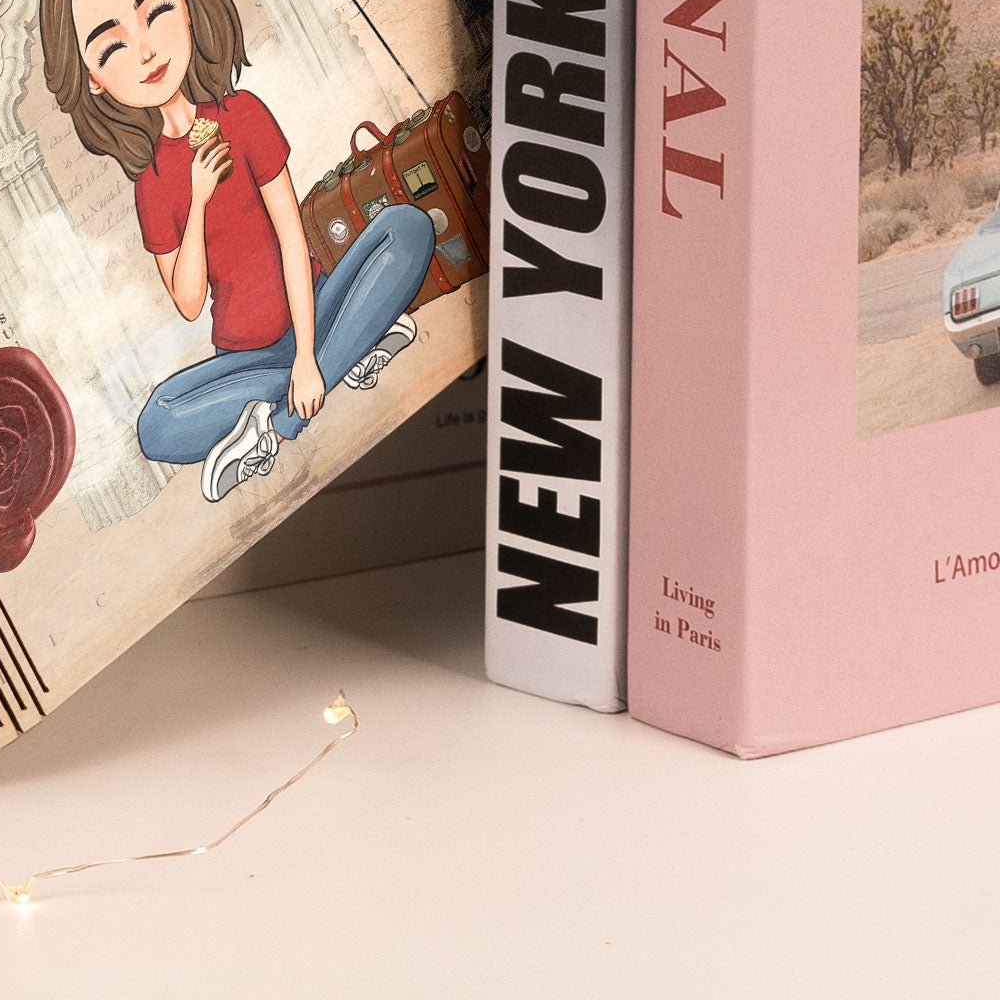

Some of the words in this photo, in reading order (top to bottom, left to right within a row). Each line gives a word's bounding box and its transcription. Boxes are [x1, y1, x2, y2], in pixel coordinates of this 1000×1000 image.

[496, 337, 602, 647] NEW
[662, 575, 716, 619] Living
[655, 610, 671, 635] in
[677, 617, 722, 652] Paris
